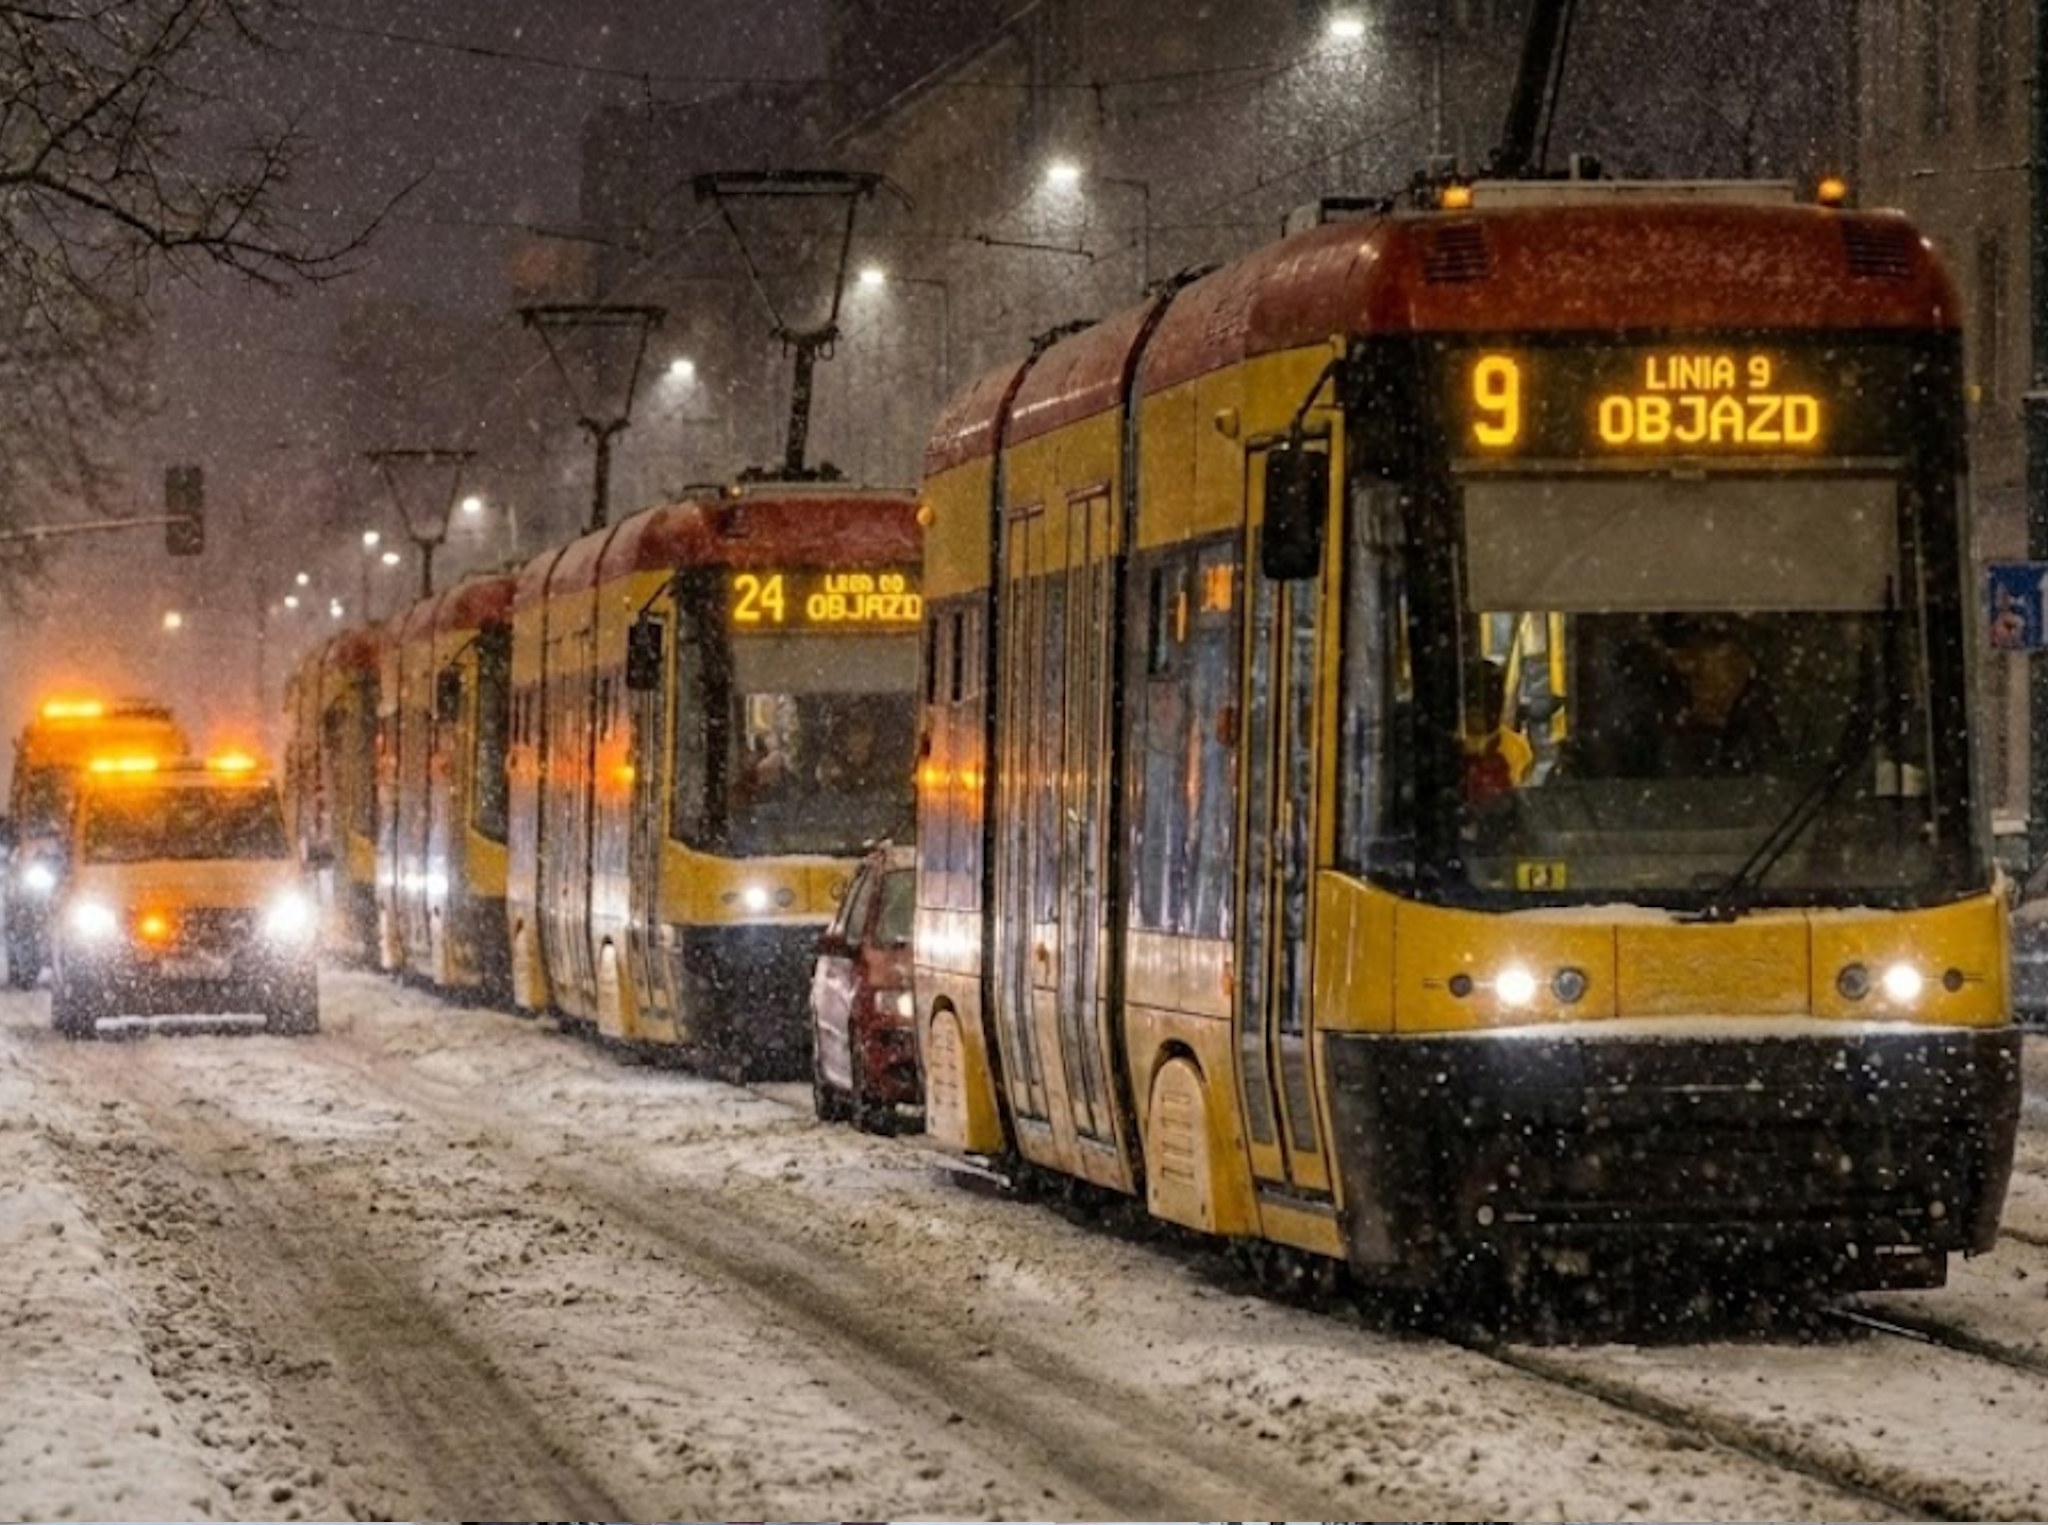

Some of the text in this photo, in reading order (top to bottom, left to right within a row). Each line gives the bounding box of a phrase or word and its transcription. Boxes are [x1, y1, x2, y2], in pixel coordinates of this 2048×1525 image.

[1645, 355, 1771, 390] LINIA 9
[1473, 355, 1520, 446] 9
[1599, 395, 1819, 443] OBJAZD
[734, 573, 785, 622] 24
